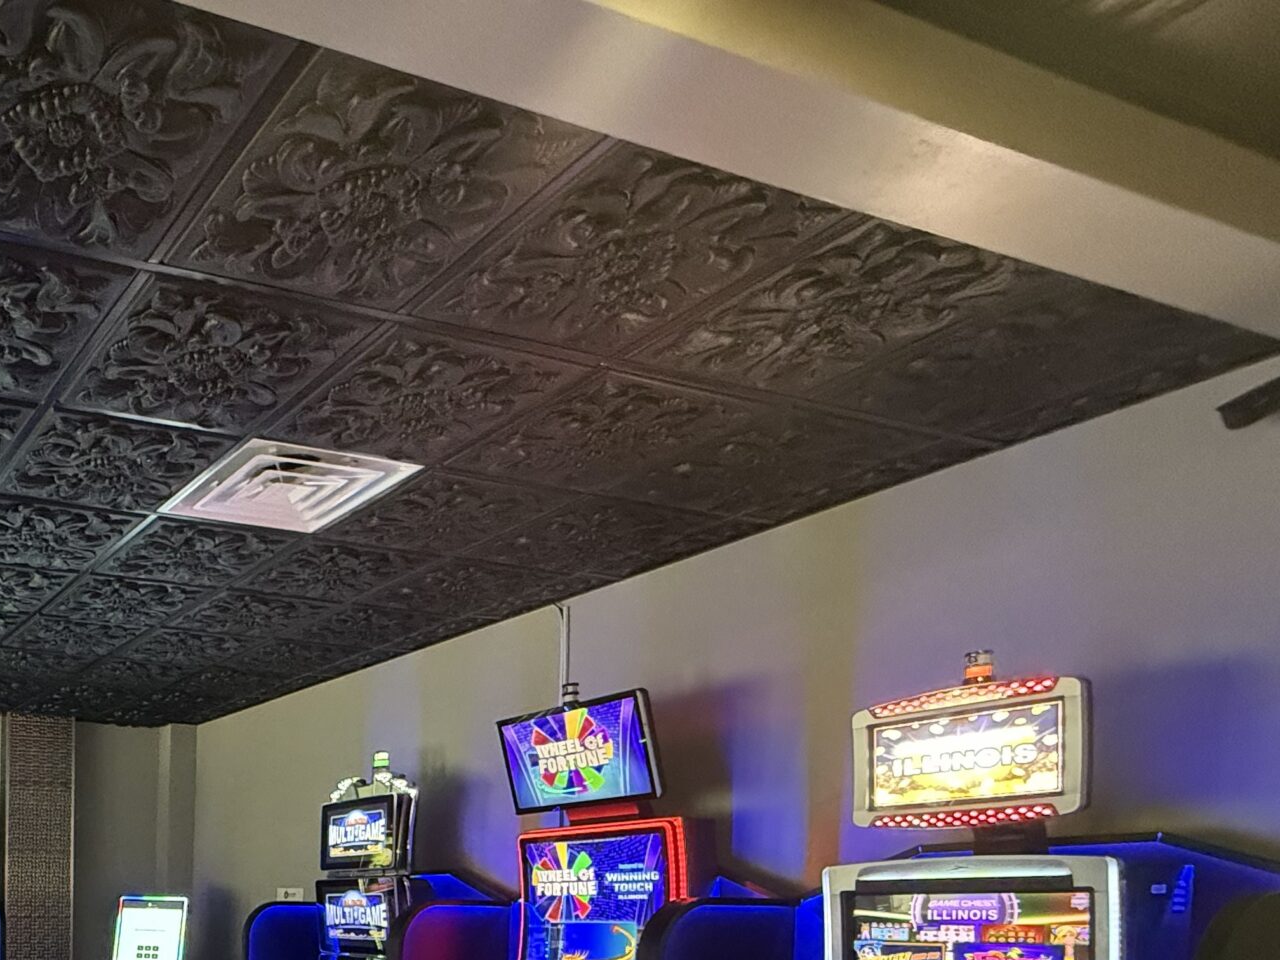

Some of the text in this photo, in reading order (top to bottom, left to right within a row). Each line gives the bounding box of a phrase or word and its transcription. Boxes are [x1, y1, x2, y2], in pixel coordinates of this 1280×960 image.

[535, 737, 584, 758] WHEEL
[539, 749, 609, 775] FORTUNE
[892, 743, 1038, 777] ILLINOIS
[329, 825, 354, 846] MULTI
[361, 819, 385, 841] GAME
[538, 869, 577, 882] WHEEL
[605, 871, 659, 881] WINNING
[537, 882, 597, 896] FORTUNE
[614, 882, 653, 892] TOUCH
[326, 903, 388, 927] MULTI GAME
[927, 909, 998, 920] ILLINOIS
